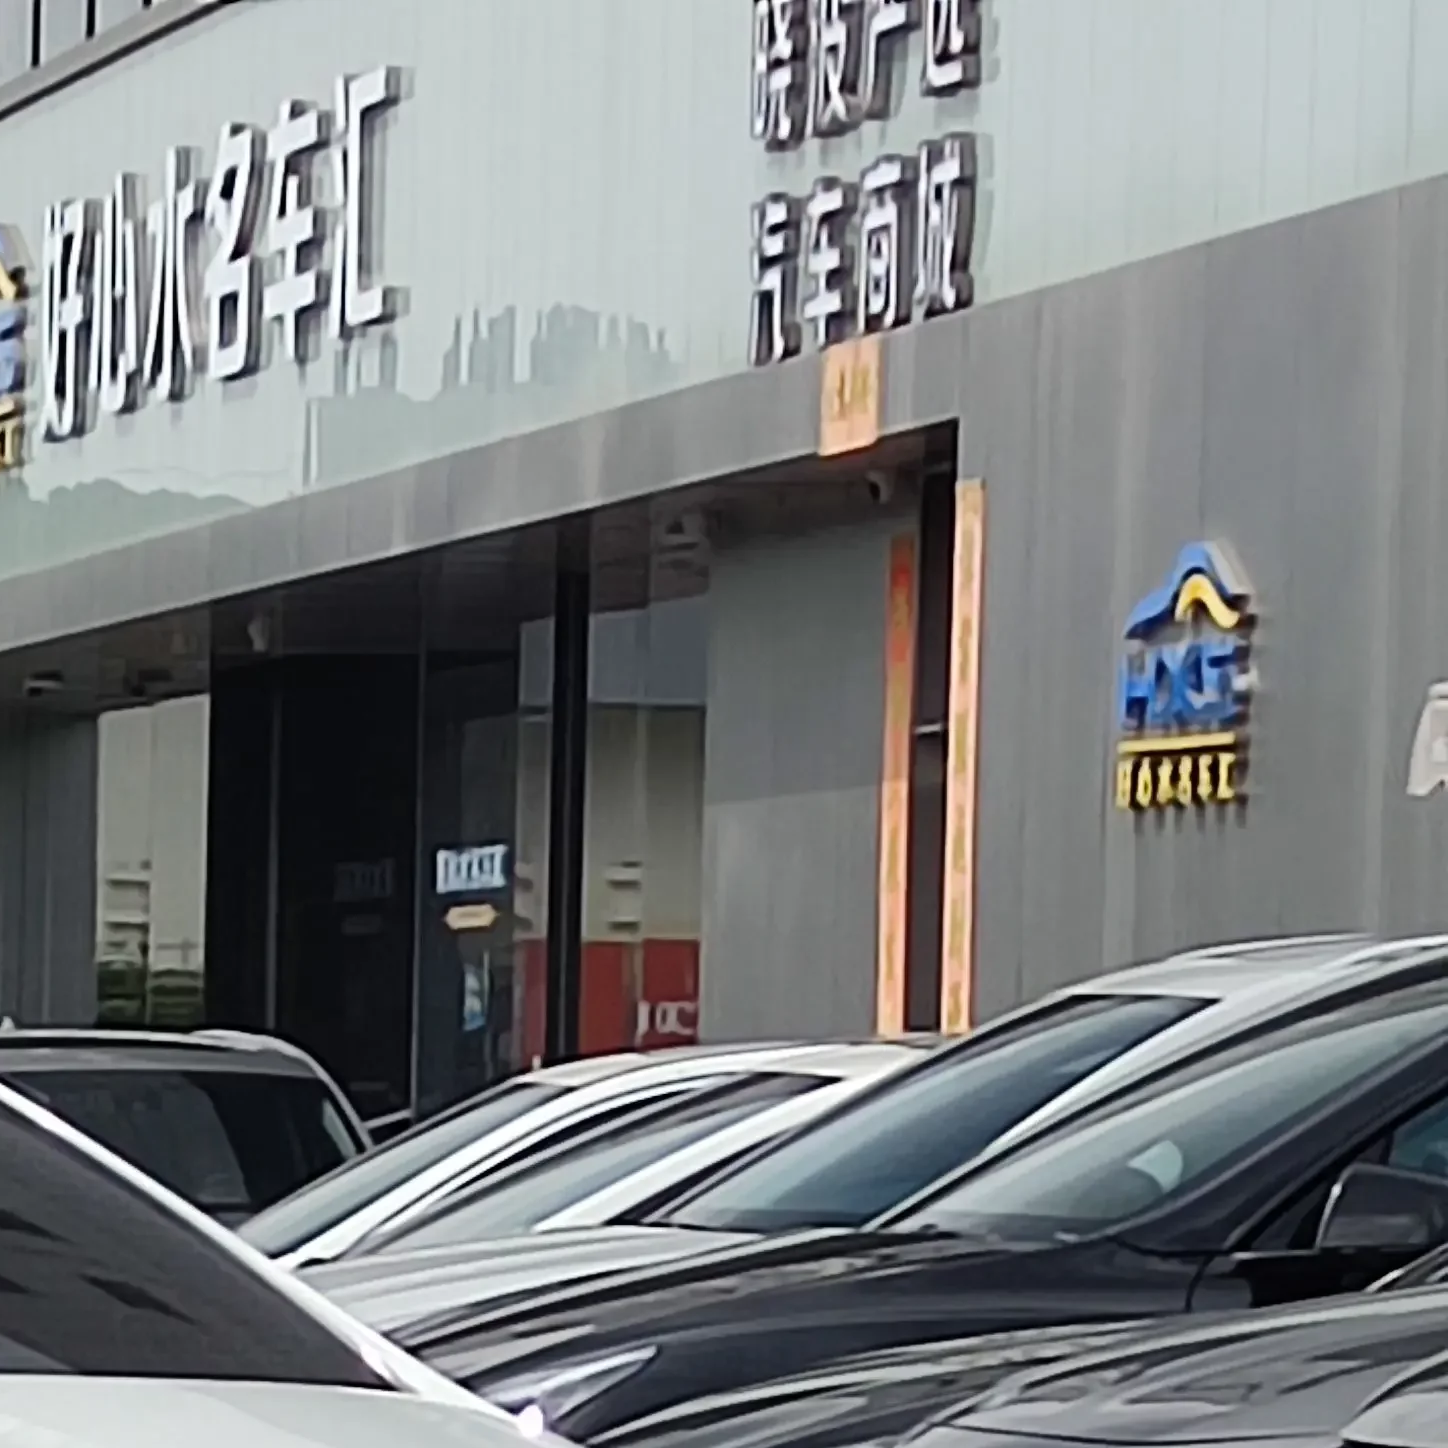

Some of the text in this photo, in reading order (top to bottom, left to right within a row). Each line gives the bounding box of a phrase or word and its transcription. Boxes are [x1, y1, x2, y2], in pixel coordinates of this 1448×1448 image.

[40, 64, 396, 440] 好心水名车汇
[749, 138, 964, 366] 汽车商城
[1116, 643, 1246, 733] HXS
